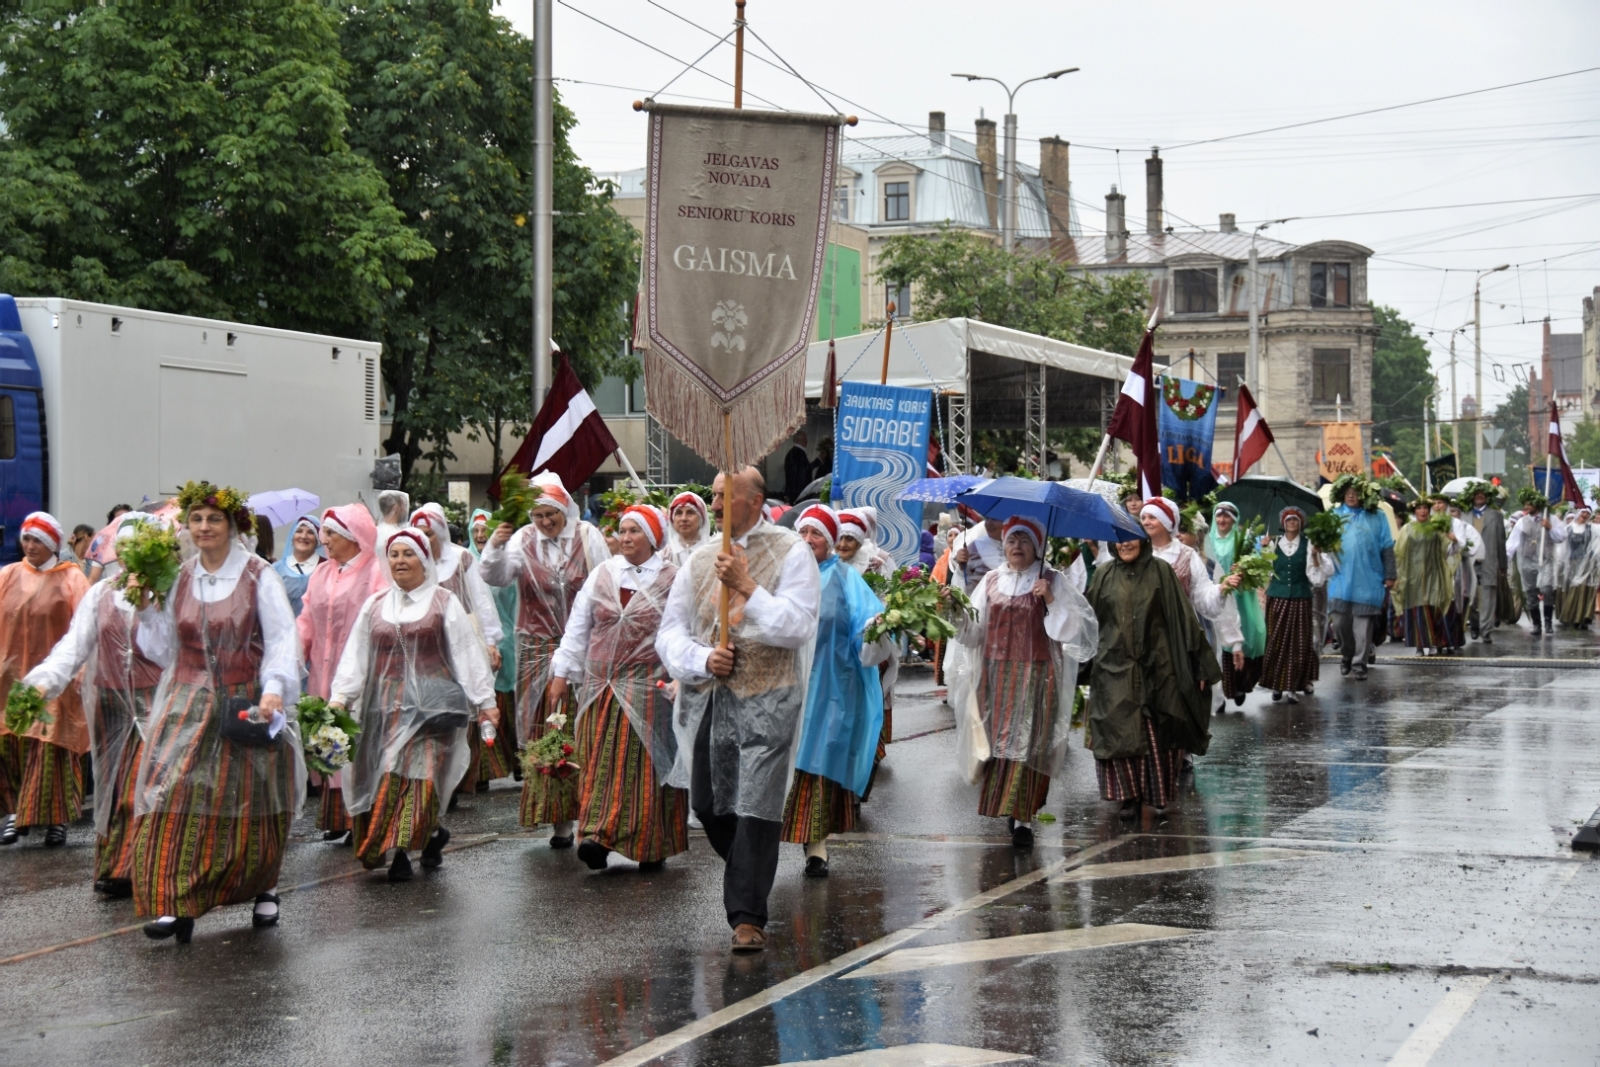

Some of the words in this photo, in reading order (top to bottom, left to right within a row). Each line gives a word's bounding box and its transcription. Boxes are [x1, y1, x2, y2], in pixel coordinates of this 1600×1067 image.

[703, 152, 780, 171] JELGAVAS
[708, 171, 771, 189] NOVADA
[677, 205, 744, 223] SENIORU
[750, 210, 796, 227] KORIS
[673, 244, 798, 281] GAISMA
[898, 399, 928, 414] KORIS
[841, 415, 924, 448] SIDRABE
[1325, 460, 1359, 474] Vilce
